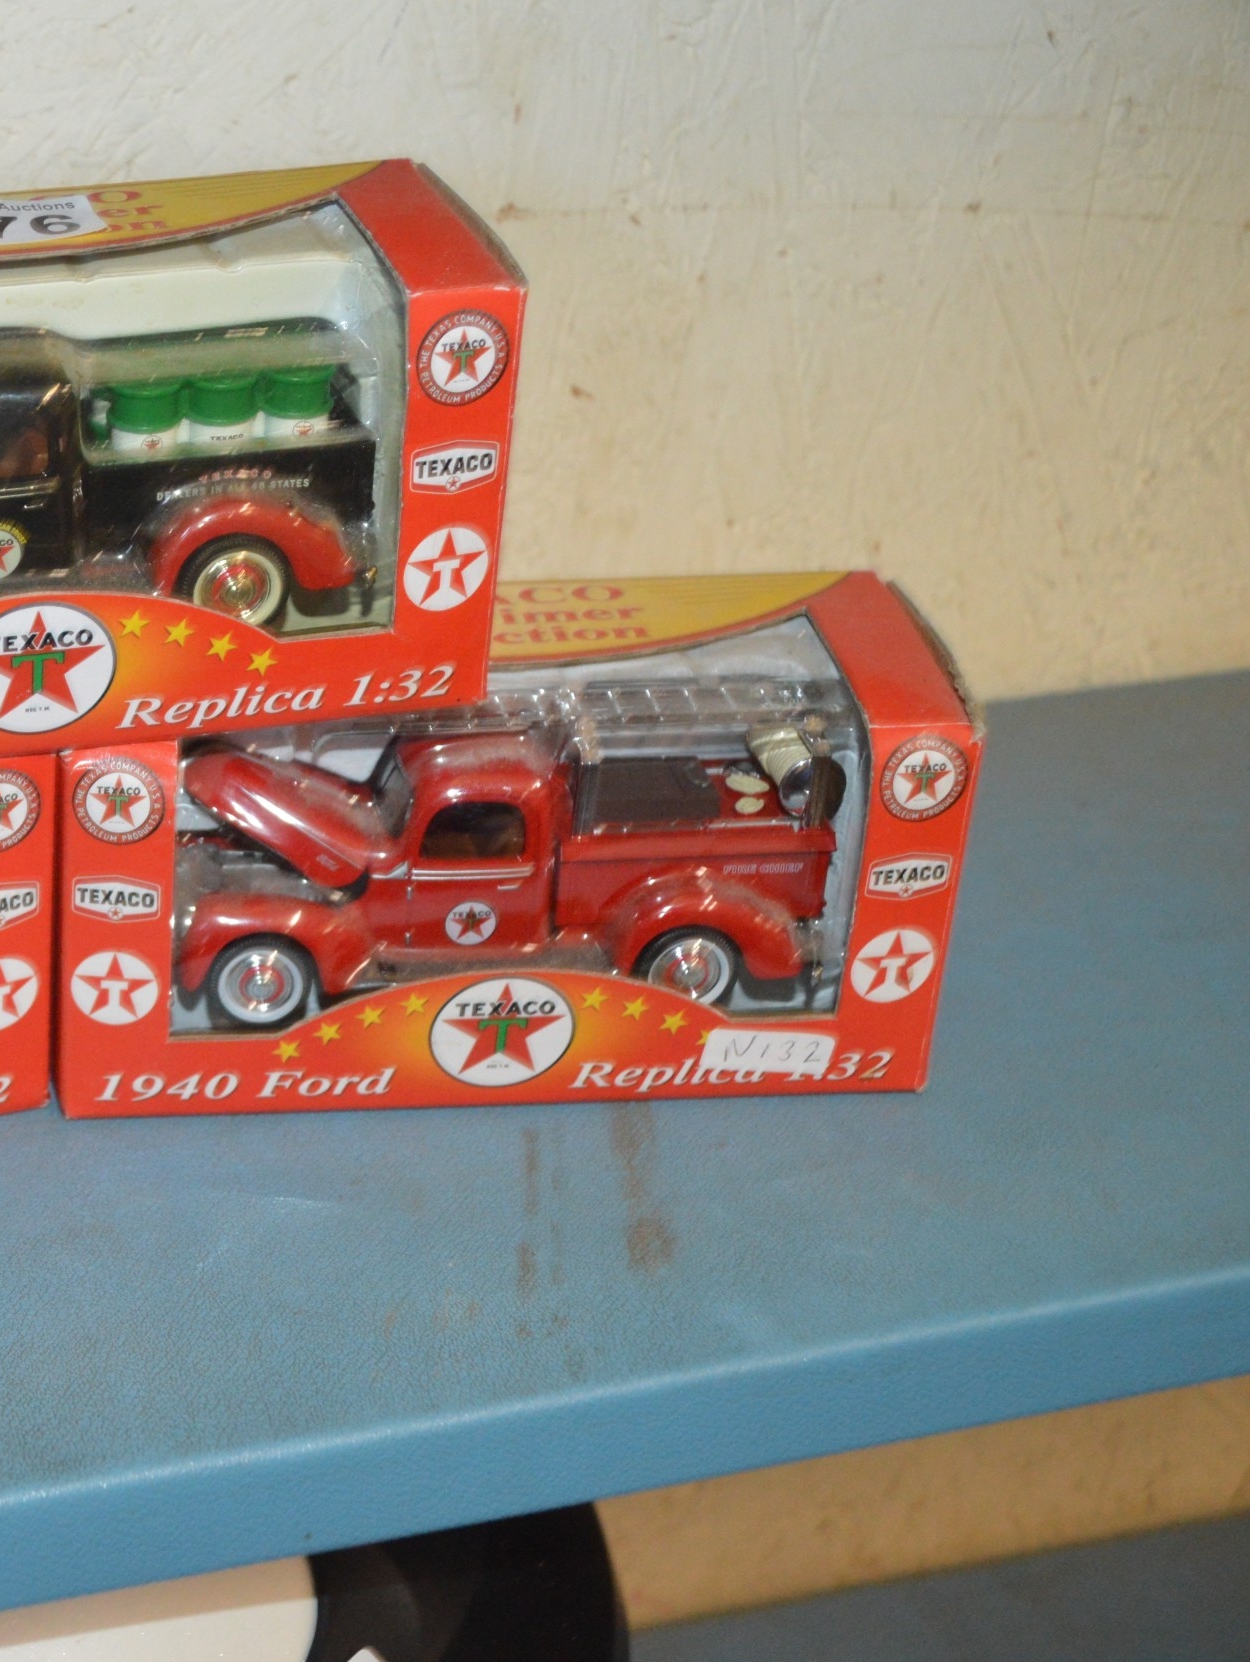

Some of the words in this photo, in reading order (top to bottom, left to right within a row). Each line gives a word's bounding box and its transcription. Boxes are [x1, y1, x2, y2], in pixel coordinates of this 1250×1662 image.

[420, 350, 429, 368] THE
[425, 319, 452, 346] TEXAS
[454, 314, 497, 333] COMPANY
[442, 338, 486, 352] TEXACO
[420, 371, 460, 403] PETROLEUM
[465, 363, 503, 401] PRODUCTS
[210, 433, 244, 441] TEXACO
[414, 449, 494, 478] TEXACO
[211, 485, 224, 495] IN
[268, 478, 310, 490] STATES
[11, 651, 66, 695] T
[115, 683, 324, 731] Replica
[341, 662, 458, 707] 1:32
[882, 770, 891, 787] THE
[889, 743, 913, 767] TEXAS
[916, 739, 958, 757] COMPANY
[904, 762, 947, 773] TEXACO
[75, 788, 85, 804] THE
[81, 764, 107, 786] TEXAS
[110, 761, 152, 781] COMPANY
[96, 785, 141, 796] TEXACO
[883, 790, 919, 820] PETROLEUM
[923, 786, 961, 818] PRODUCTS
[2, 813, 36, 848] PRODUCTS
[76, 807, 117, 841] PETROLEUM
[122, 814, 158, 842] PRODUCTS
[871, 862, 947, 887] TEXACO
[76, 887, 156, 909] TEXACO
[455, 1000, 556, 1017] TEXACO
[478, 1017, 528, 1054] T
[93, 1072, 240, 1102] 1940
[256, 1066, 396, 1098] Ford
